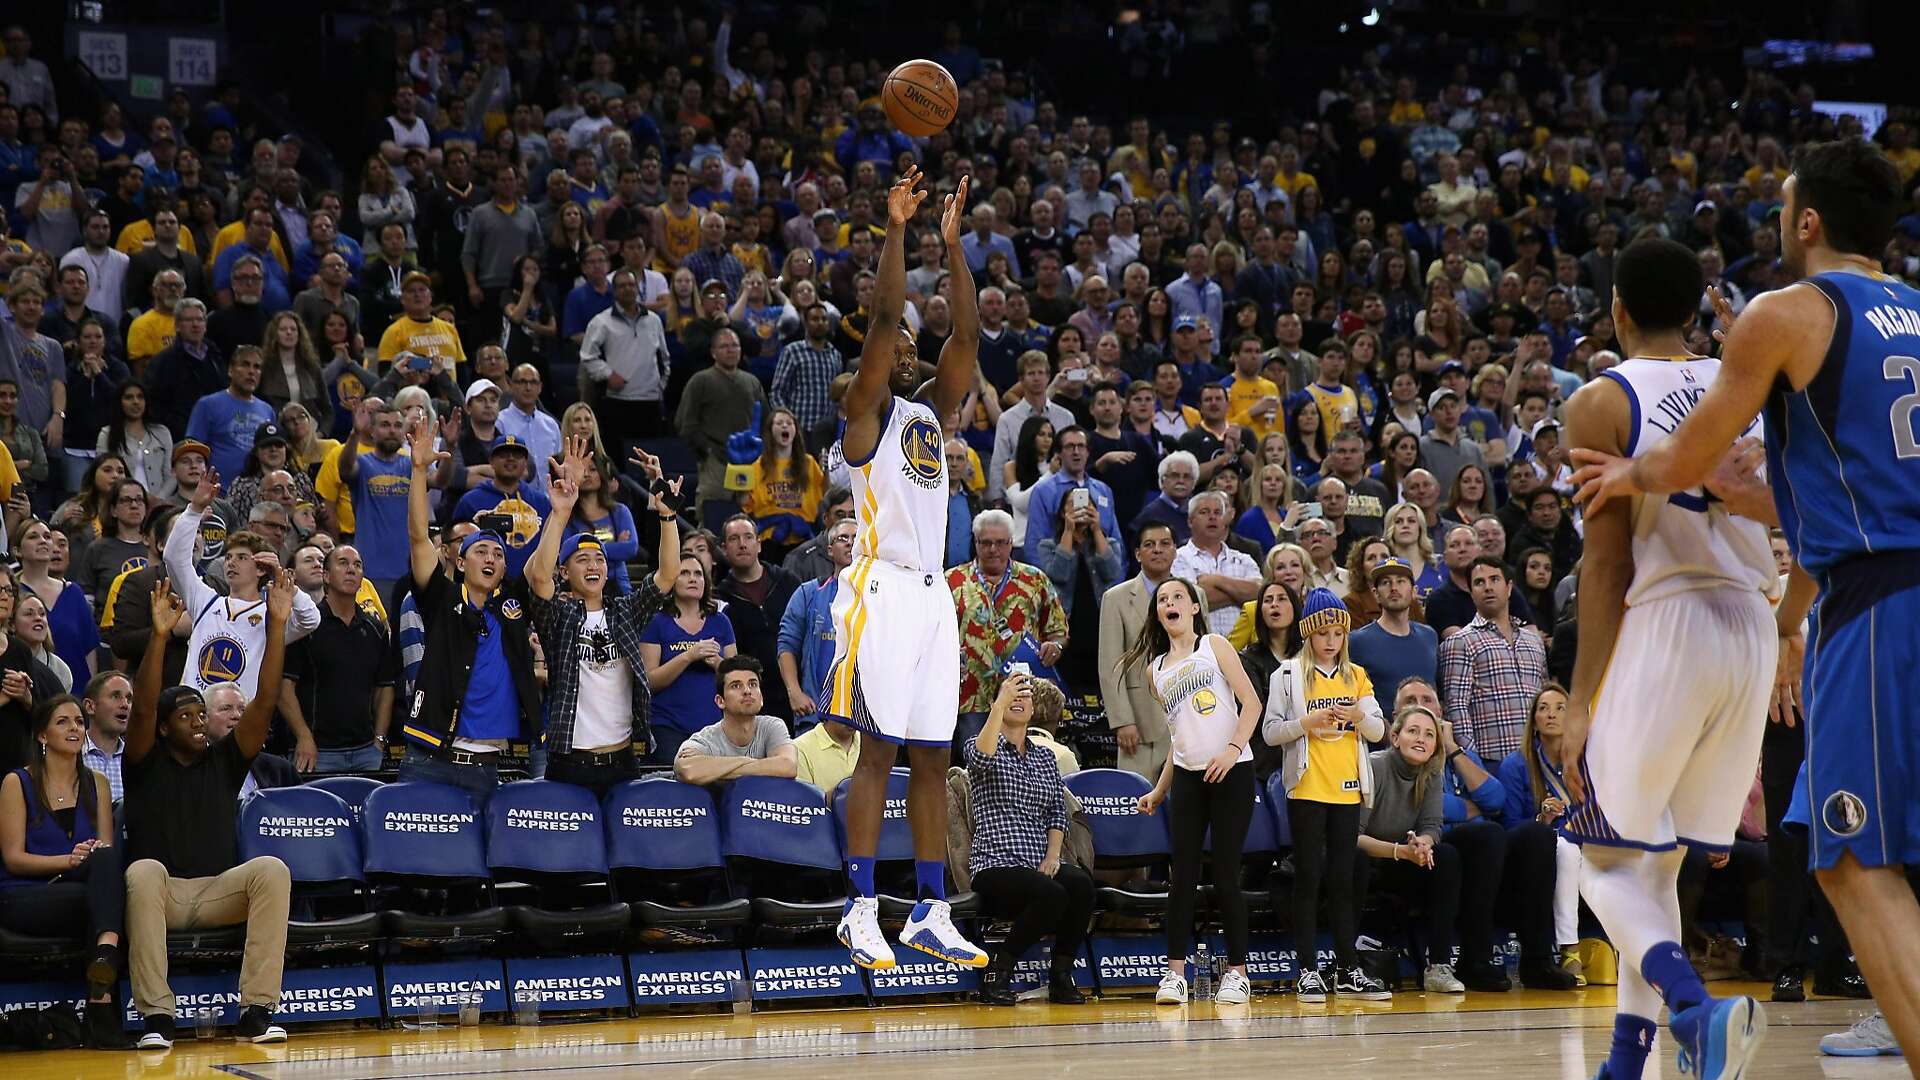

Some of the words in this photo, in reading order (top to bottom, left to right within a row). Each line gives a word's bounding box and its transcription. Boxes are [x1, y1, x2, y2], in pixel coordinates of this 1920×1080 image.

[84, 53, 122, 75] 113
[176, 58, 210, 81] 114
[925, 430, 939, 448] 40
[222, 647, 232, 661] 11
[742, 798, 826, 816] AMERICAN
[1076, 796, 1138, 806] AMERICA
[384, 811, 473, 823] AMERICAN
[507, 808, 594, 822] AMERICAN
[622, 807, 707, 817] AMERICAN
[741, 808, 812, 825] EXPRESS
[1082, 805, 1139, 816] XPRESS
[259, 816, 349, 827] AMERICAN
[384, 821, 460, 833] EXPRESS
[507, 818, 580, 832] EXPRESS
[623, 817, 693, 828] EXPRESS
[259, 826, 335, 838] EXPRESS
[637, 969, 742, 983] AMERICAN
[754, 964, 857, 980] AMERICAN
[873, 962, 974, 976] AMERICAN
[390, 979, 501, 995] AMERICAN
[514, 975, 622, 990] AMERICAN
[755, 977, 842, 992] EXPRESS
[874, 974, 959, 988] EXPRESS
[278, 985, 374, 1001] MERICAN
[514, 988, 605, 1003] EXPRESS
[637, 982, 726, 996] EXPRESS
[126, 992, 242, 1009] ARICAN
[390, 993, 484, 1008] EXPRESS
[127, 1006, 225, 1022] ERESS
